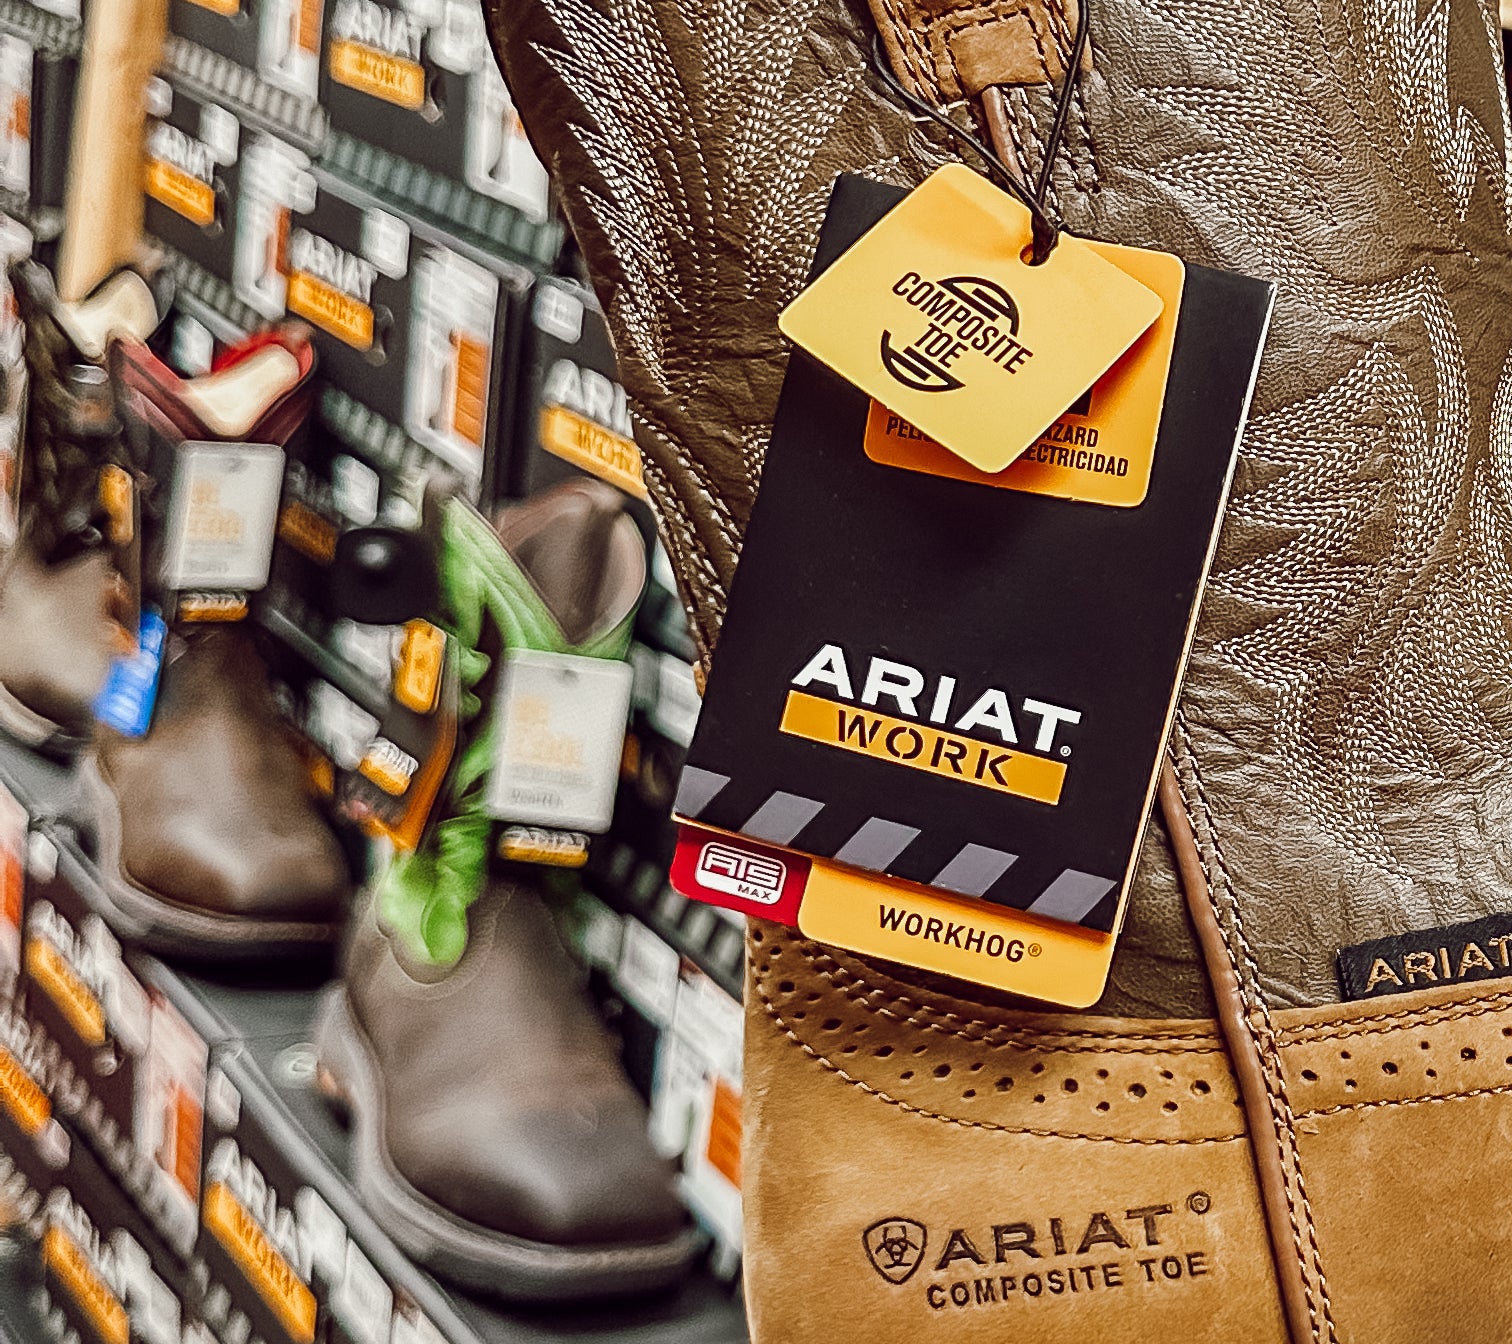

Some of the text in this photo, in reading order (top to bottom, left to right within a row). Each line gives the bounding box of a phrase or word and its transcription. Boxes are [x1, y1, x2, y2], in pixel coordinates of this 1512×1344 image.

[892, 272, 1034, 375] COMPOSITE
[914, 323, 970, 369] TOE
[838, 709, 1013, 787] WORK
[703, 846, 782, 888] ATS
[737, 882, 773, 902] MAX
[926, 1251, 1209, 1309] COMPOSITE TOE
